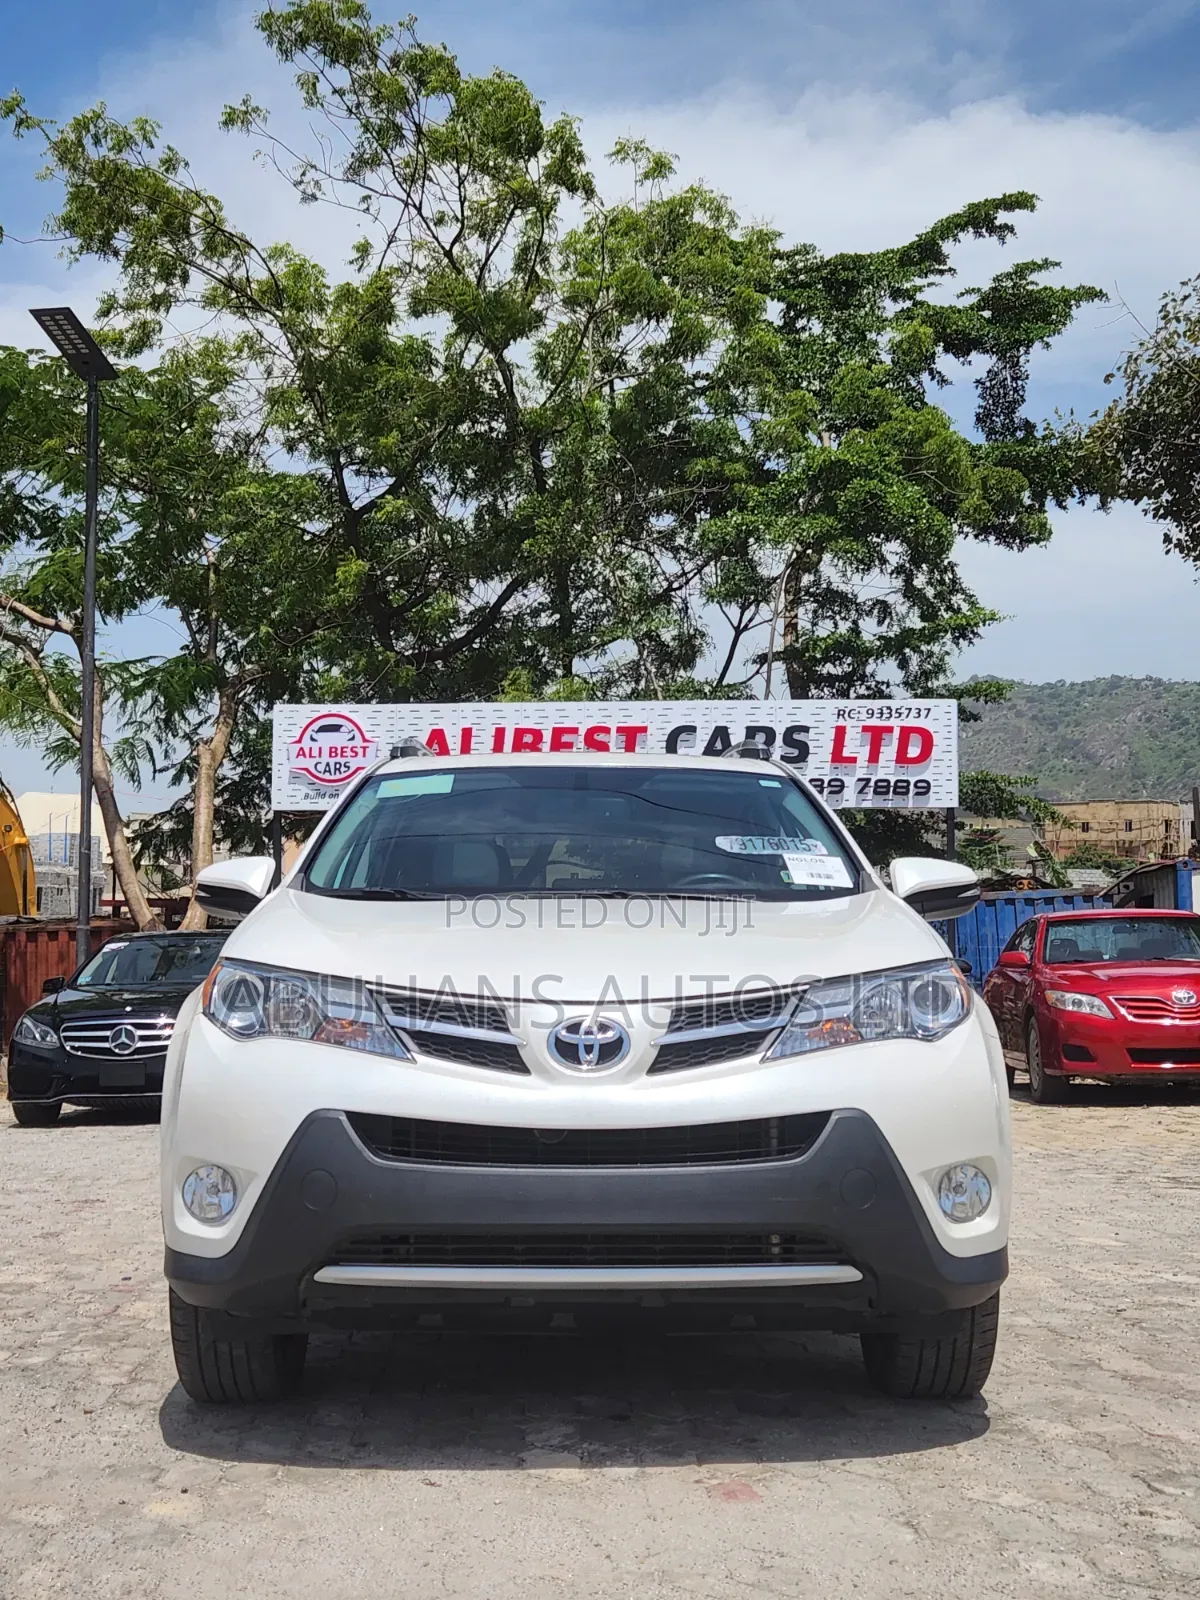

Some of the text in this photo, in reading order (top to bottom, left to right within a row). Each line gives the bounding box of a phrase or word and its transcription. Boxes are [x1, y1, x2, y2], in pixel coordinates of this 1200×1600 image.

[866, 707, 931, 720] 9335737
[295, 746, 370, 759] ALI BEST
[830, 725, 935, 765] LTD
[314, 761, 351, 776] CARS
[856, 777, 931, 796] 7889
